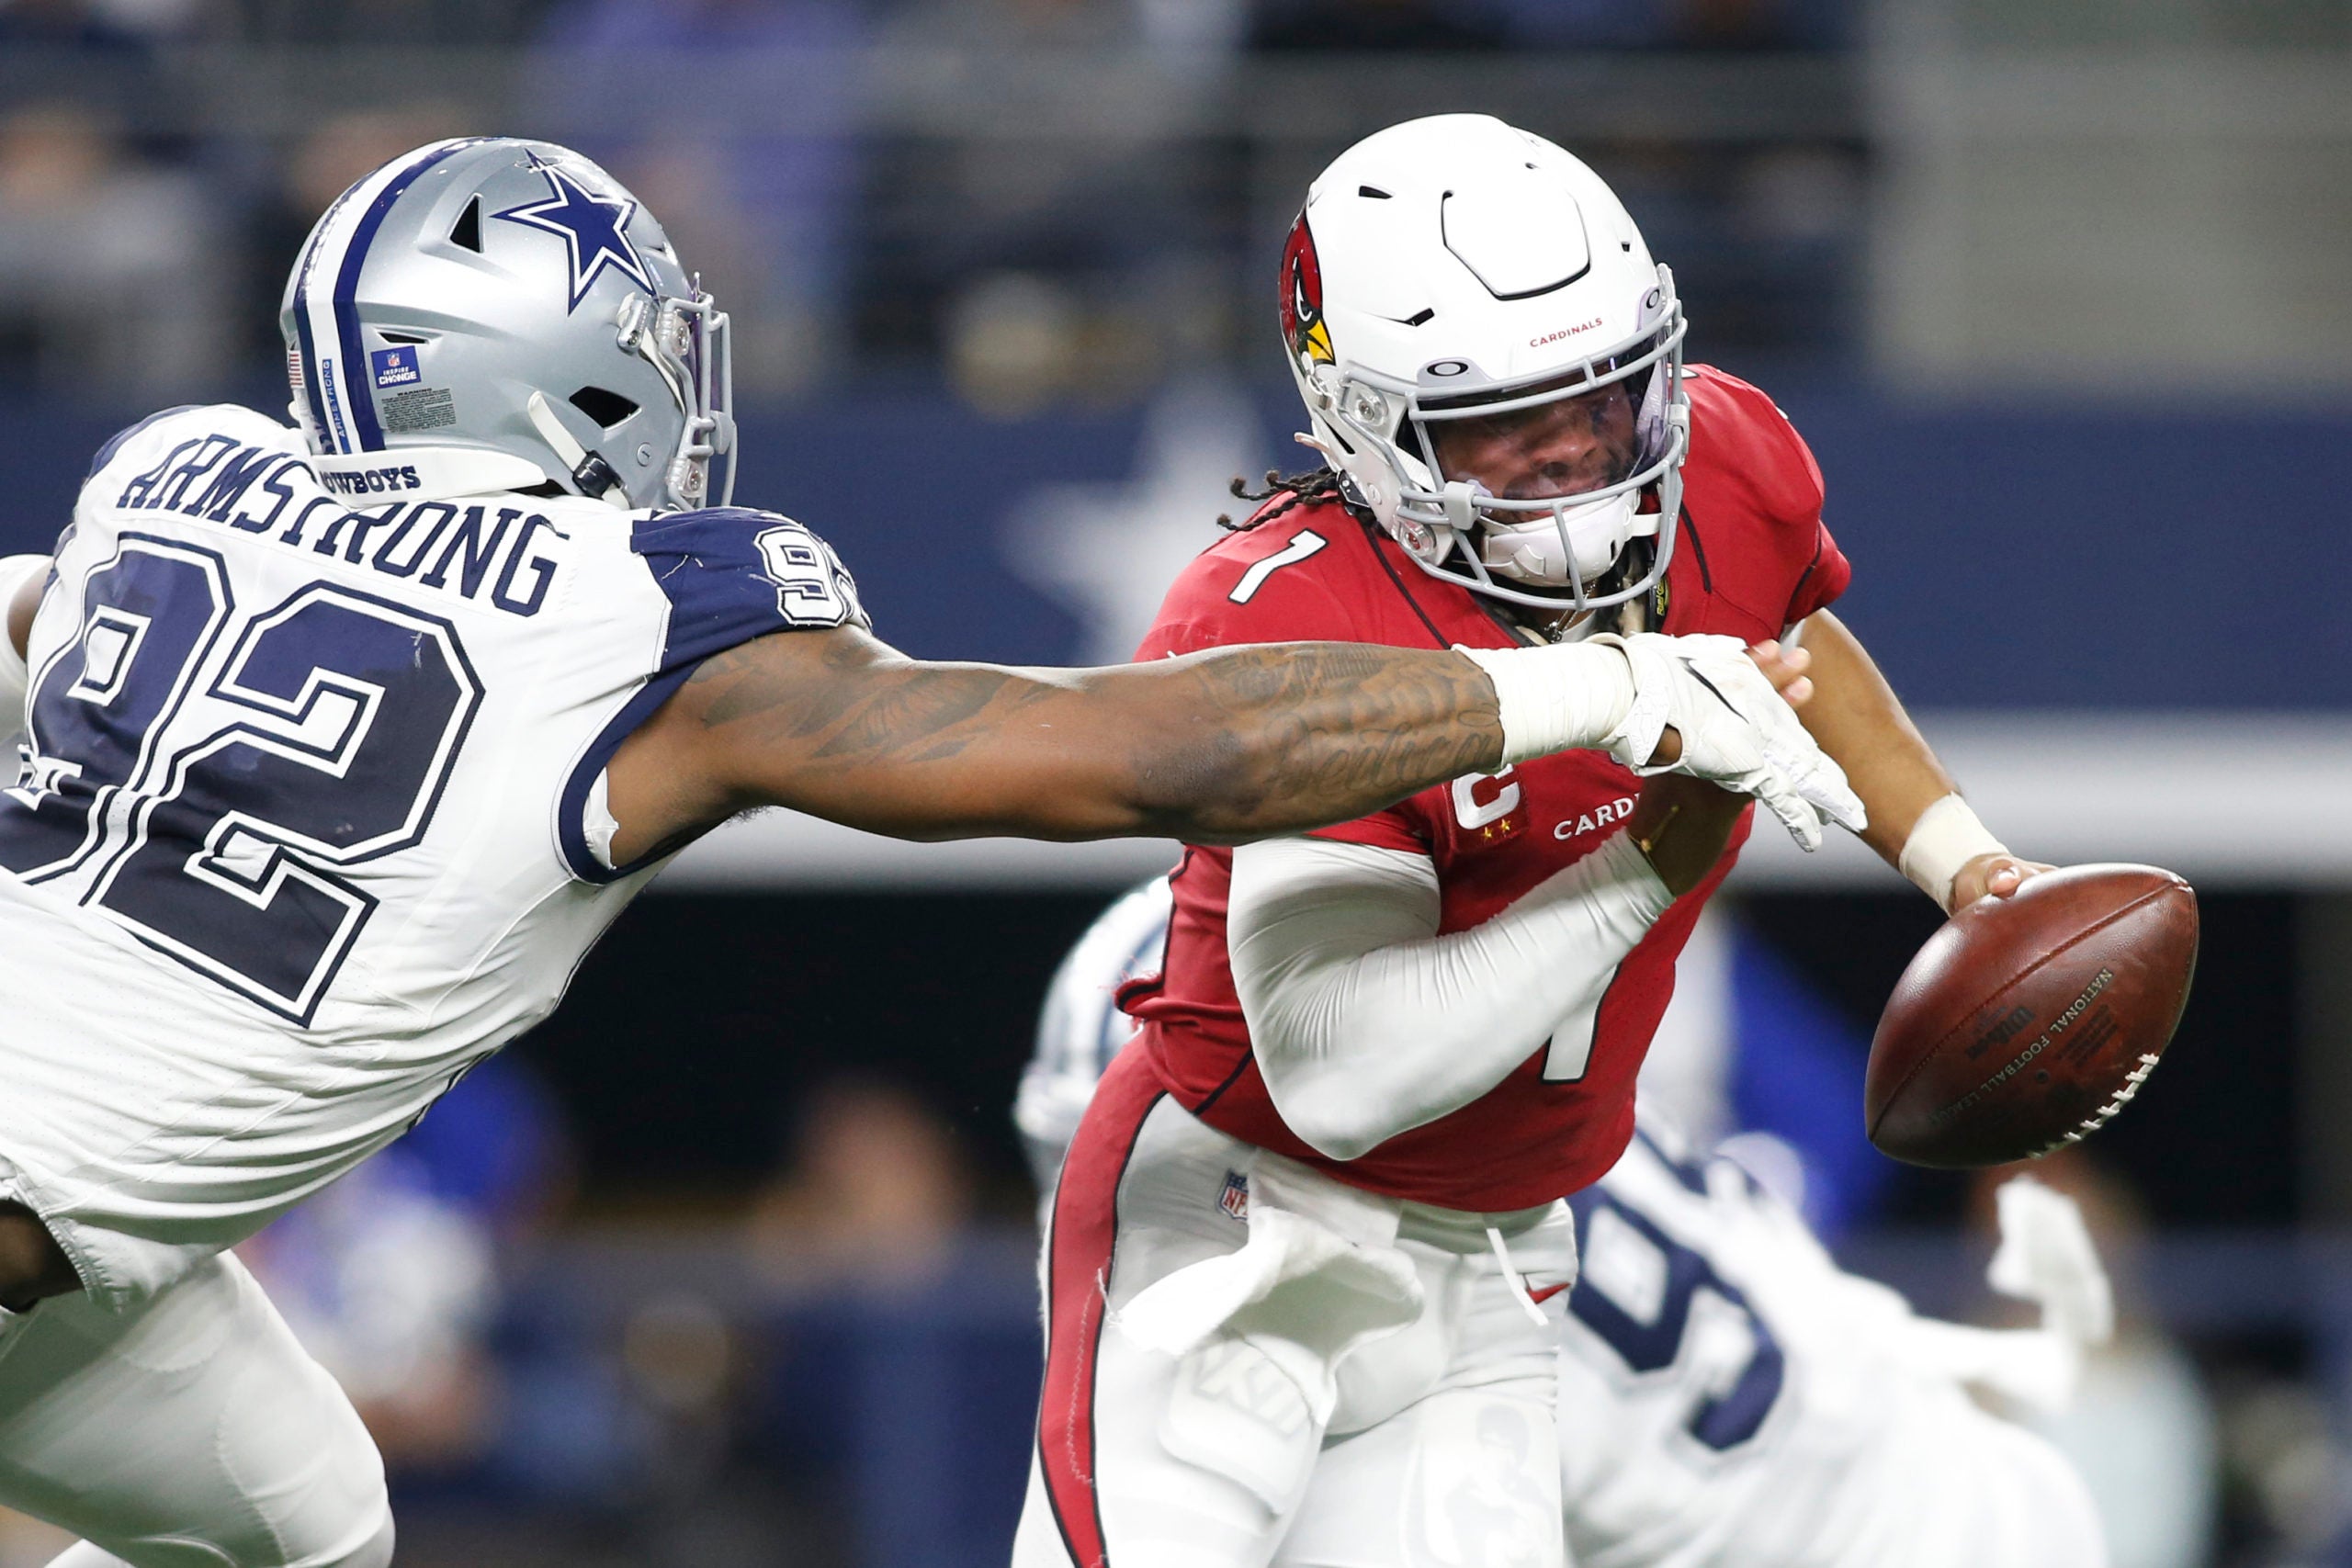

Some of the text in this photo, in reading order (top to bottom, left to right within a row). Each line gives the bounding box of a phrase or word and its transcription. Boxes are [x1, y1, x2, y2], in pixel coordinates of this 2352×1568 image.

[1530, 317, 1603, 347] CARDINALS
[379, 371, 417, 385] CHANGE
[382, 366, 410, 376] INSPIRE
[319, 465, 422, 494] OWBOYS
[1227, 528, 1329, 605] 1
[0, 530, 487, 1029] 92
[1451, 762, 1521, 830] C
[1553, 792, 1640, 841] CARD
[2050, 967, 2113, 1032] NATIONAL
[1980, 1034, 2051, 1092] FOOTBALL
